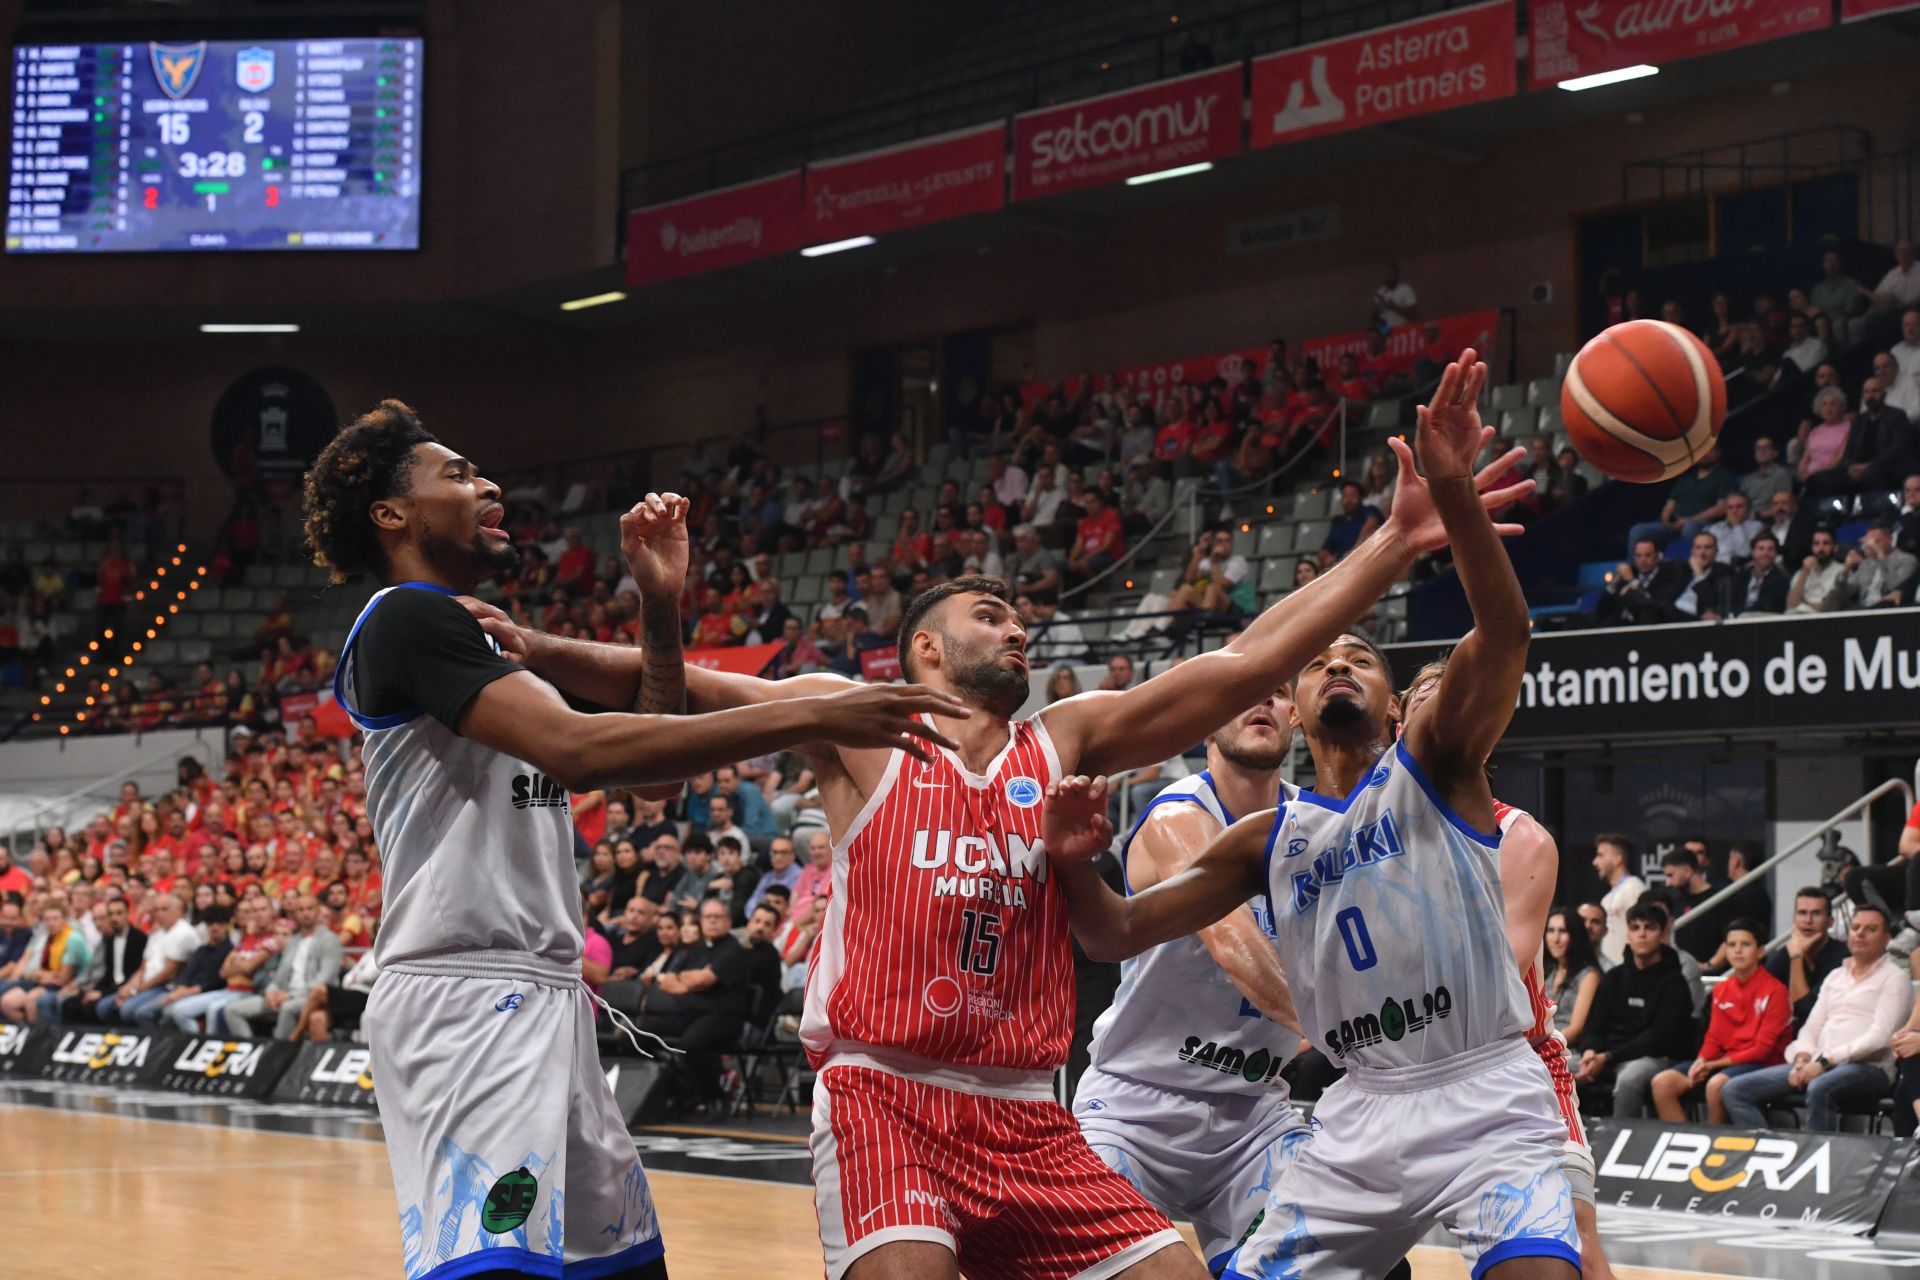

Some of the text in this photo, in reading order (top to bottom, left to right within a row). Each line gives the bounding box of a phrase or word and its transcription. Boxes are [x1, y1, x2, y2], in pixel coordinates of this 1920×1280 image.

[1356, 25, 1469, 75] Asterra
[1355, 63, 1487, 116] Partners
[157, 112, 190, 145] 15
[243, 111, 265, 144] 2
[1031, 95, 1219, 168] setcomur
[178, 151, 246, 178] 3:28
[1764, 640, 1828, 696] de
[912, 829, 1047, 885] UCAM
[934, 875, 1028, 911] MURCIA
[959, 908, 1001, 977] 15
[1336, 905, 1378, 972] 0
[52, 1031, 152, 1070] LIBERA
[174, 1038, 265, 1077] LIBERA
[1598, 1128, 1831, 1195] LIBERA
